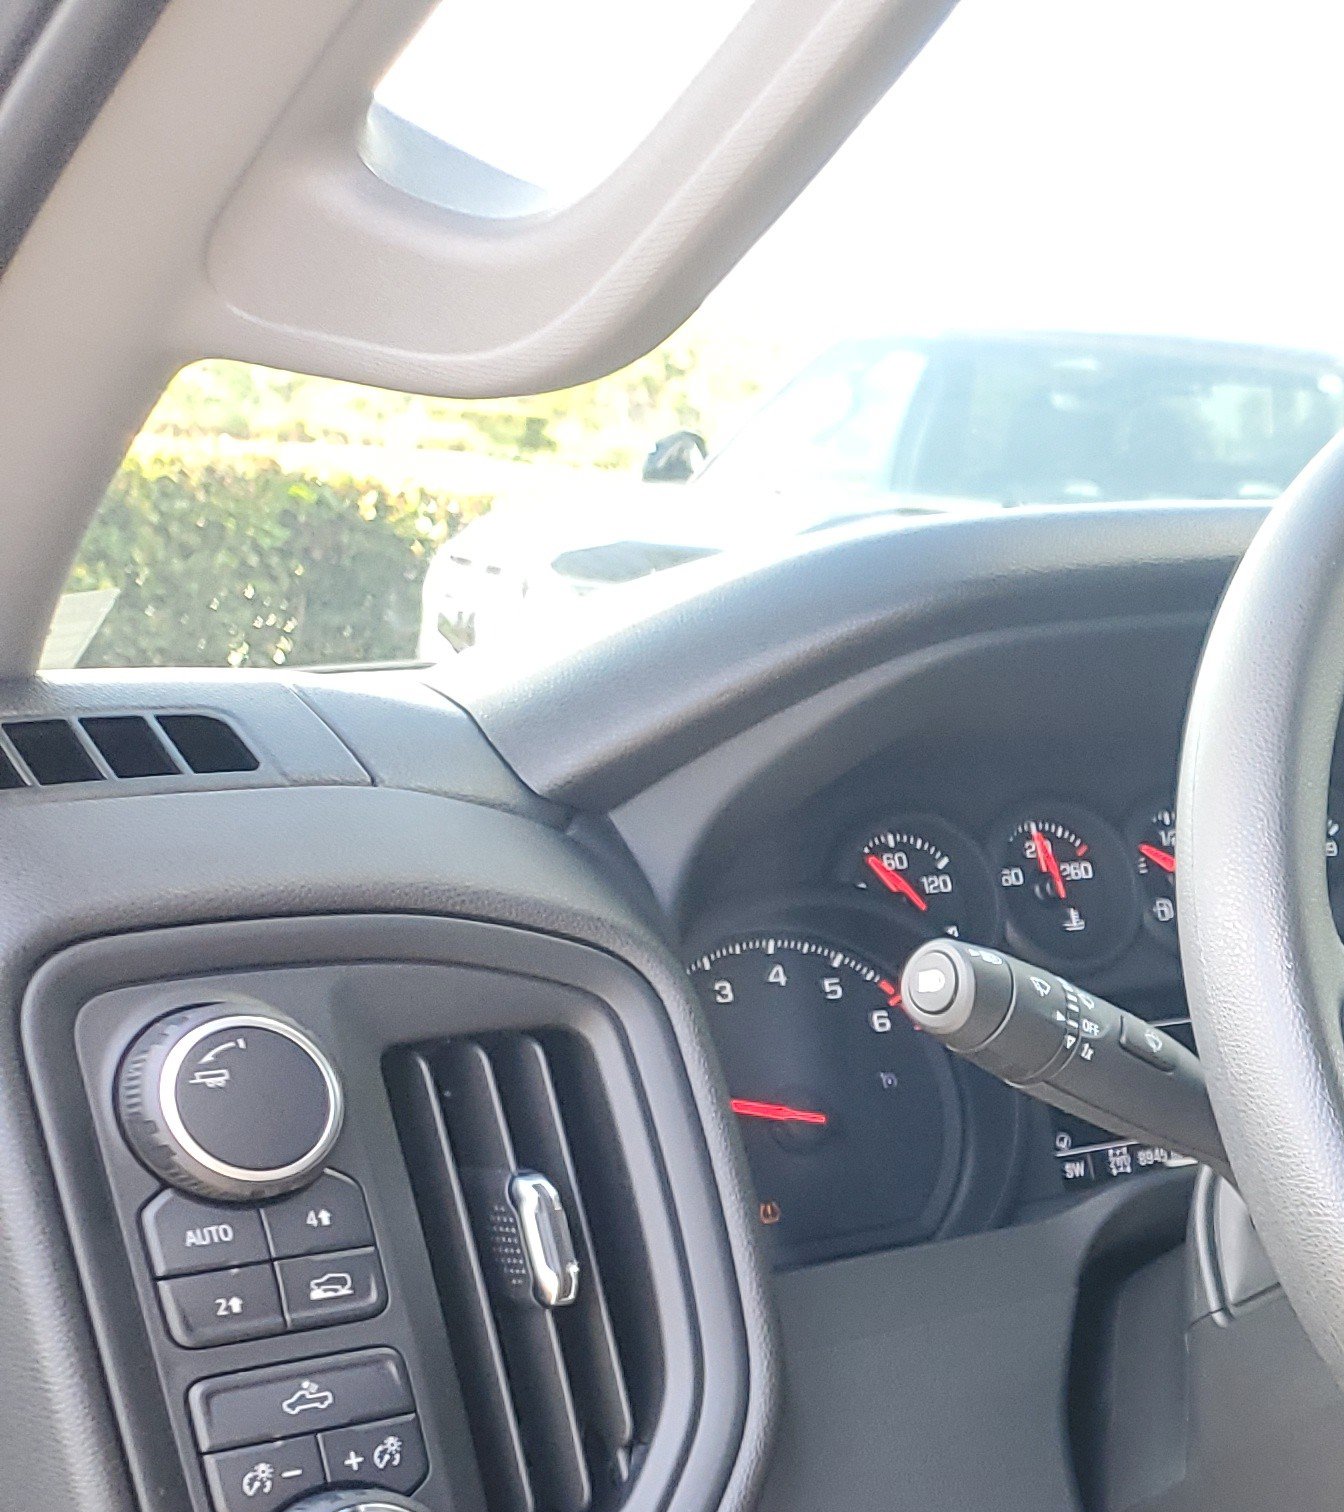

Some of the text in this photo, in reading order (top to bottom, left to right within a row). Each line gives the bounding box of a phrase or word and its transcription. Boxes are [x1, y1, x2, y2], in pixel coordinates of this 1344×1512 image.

[921, 875, 952, 894] 120
[768, 964, 788, 987] 4
[713, 980, 734, 1003] 3
[823, 977, 843, 1000] 5
[871, 1009, 892, 1033] 6
[1081, 1018, 1100, 1037] OFF
[184, 1224, 234, 1248] AUTO
